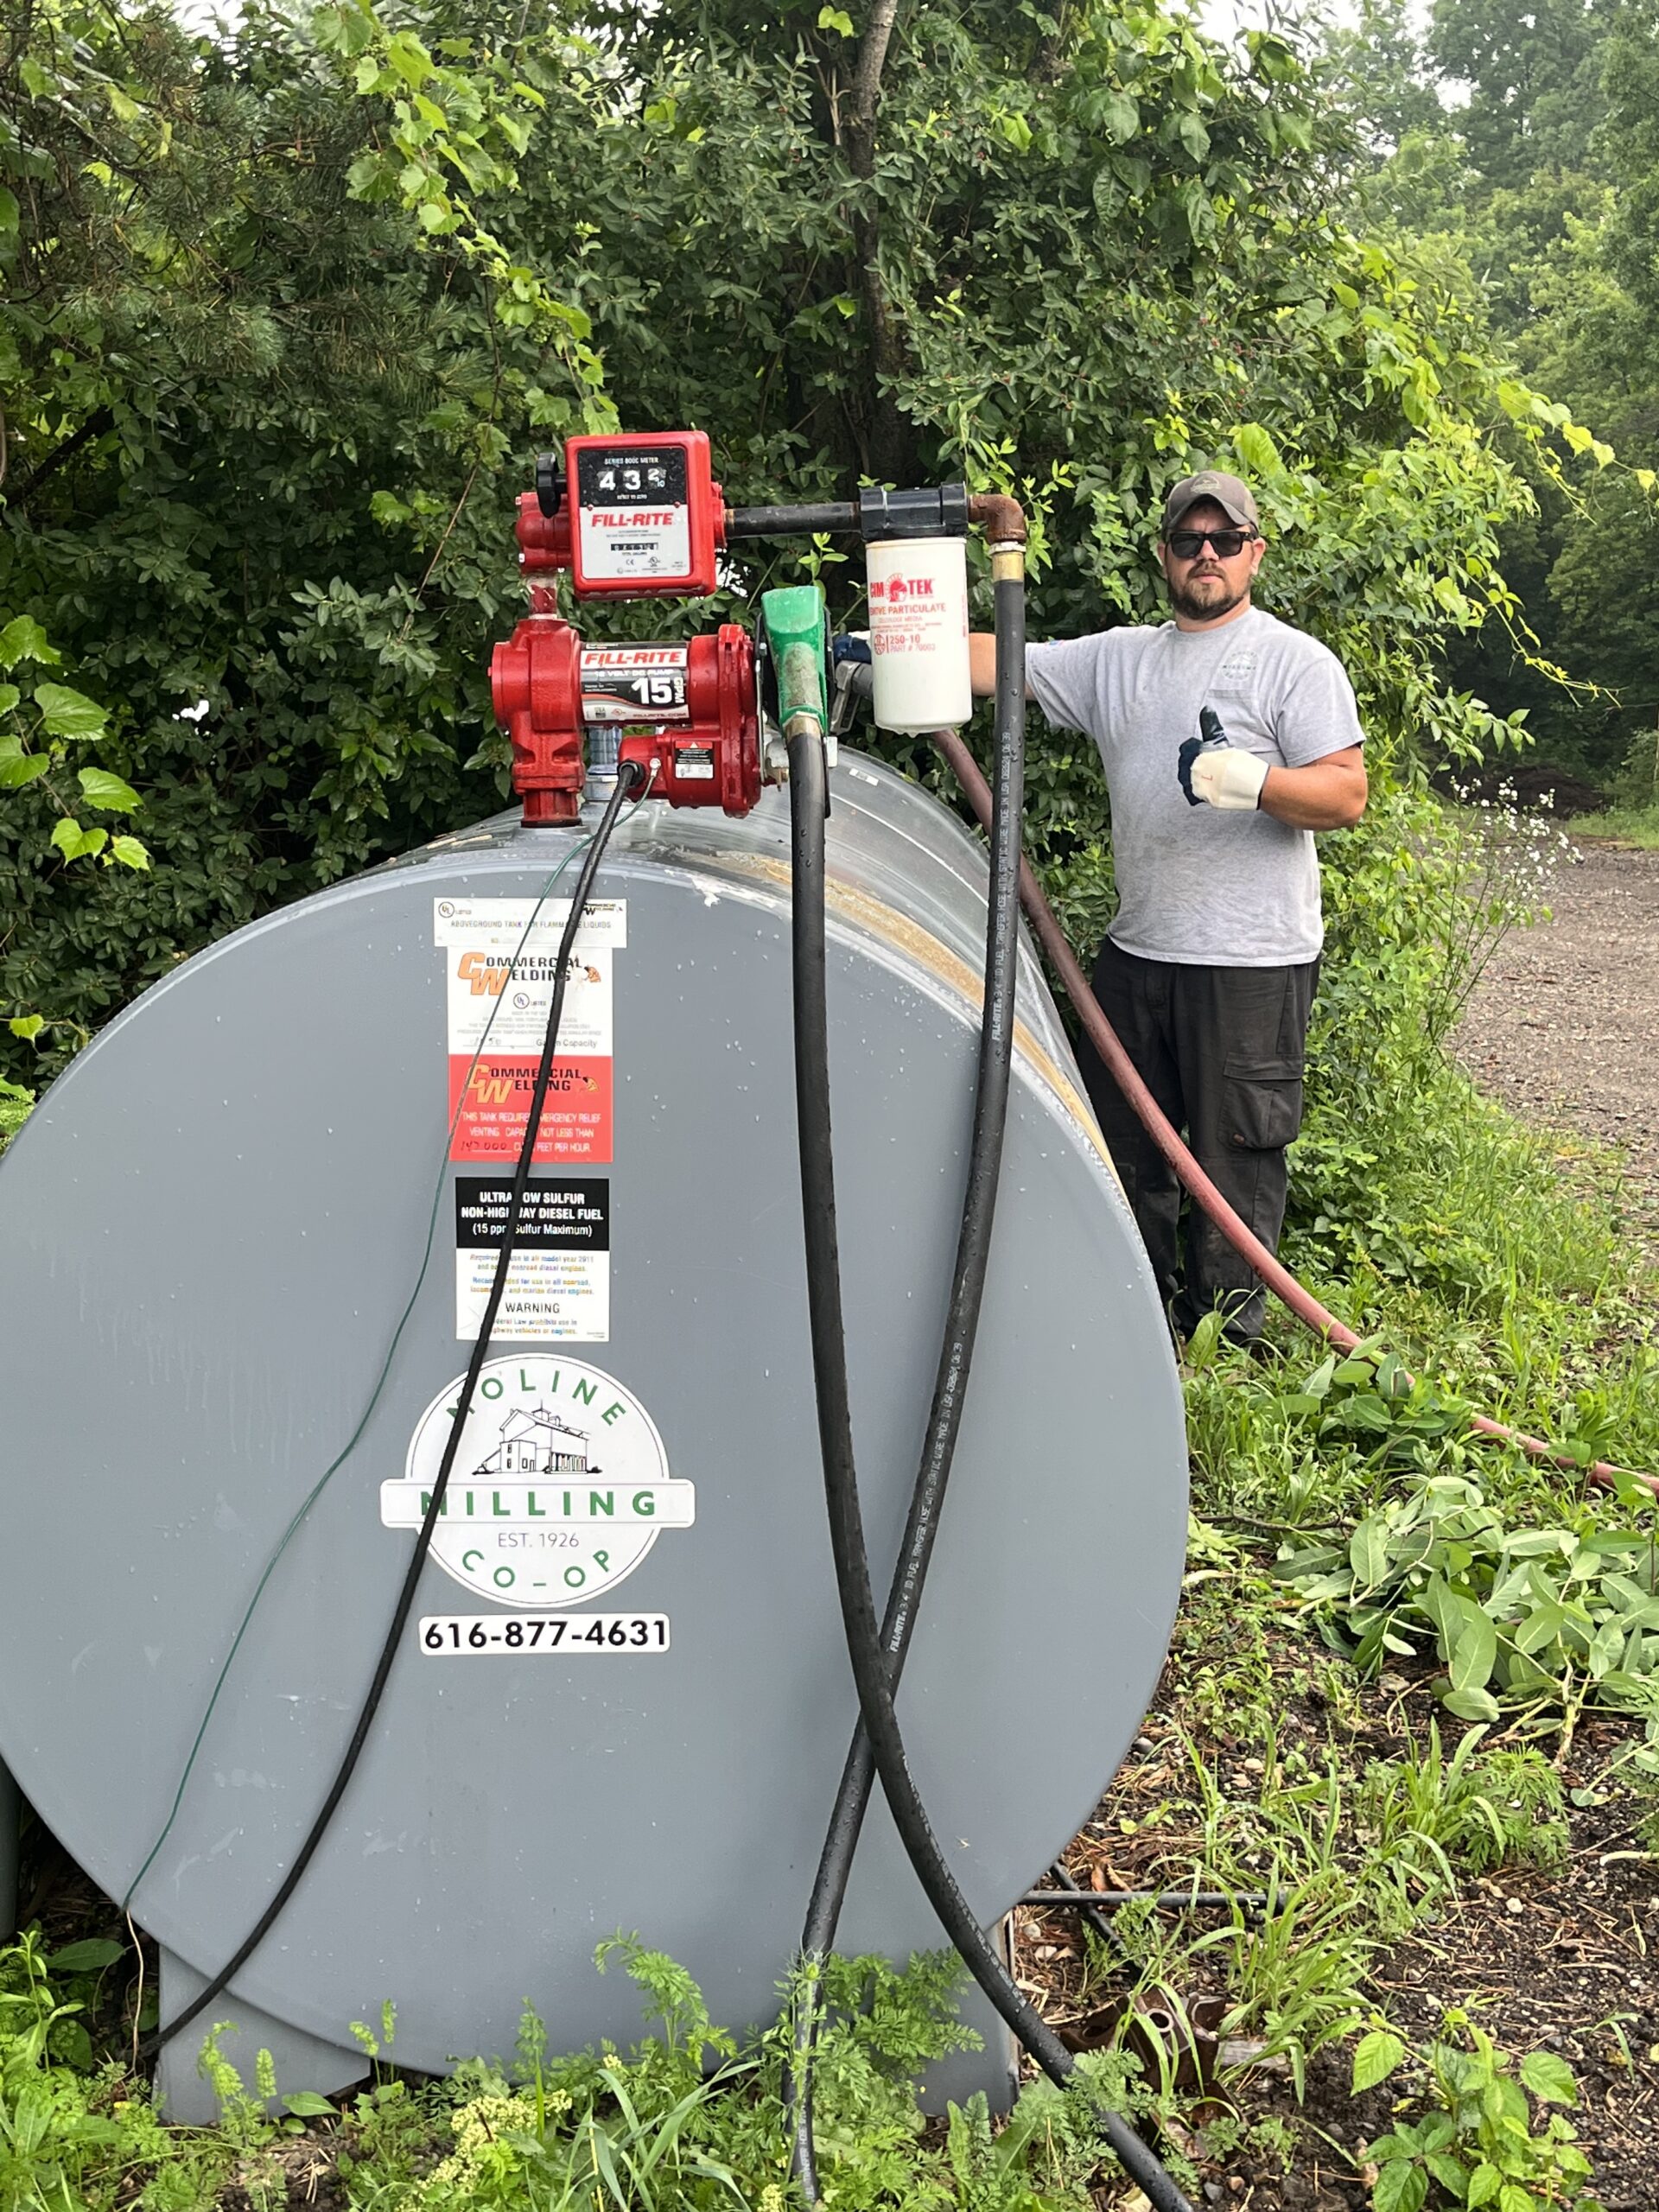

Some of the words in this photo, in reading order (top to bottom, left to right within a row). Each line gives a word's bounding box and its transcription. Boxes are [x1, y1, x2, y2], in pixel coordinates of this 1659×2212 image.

[592, 512, 673, 527] FILL-RITE
[907, 578, 933, 595] TEK
[888, 603, 946, 615] PARTICULATE
[890, 634, 920, 644] 250-10
[585, 652, 682, 664] FILL-RITE
[632, 677, 672, 704] 15
[674, 677, 685, 703] GPM
[458, 952, 582, 979] COMMERCAL
[563, 1039, 597, 1048] Capacity
[467, 1065, 582, 1089] COMMECIAL
[477, 1079, 570, 1104] WELNG
[462, 1112, 478, 1122] THIS
[480, 1112, 497, 1122] TANK
[499, 1112, 530, 1122] REQUIRE
[540, 1113, 576, 1122] MERGENCY
[578, 1113, 601, 1123] RELIEF
[469, 1127, 499, 1137] VENTING
[505, 1127, 528, 1137] CAPAC
[540, 1127, 555, 1137] NOT
[556, 1128, 574, 1137] LESS
[575, 1128, 594, 1137] THAN
[537, 1142, 552, 1152] FEET
[555, 1142, 568, 1152] PER
[570, 1142, 591, 1153] HOUR.
[480, 1191, 512, 1203] ULTRA
[523, 1192, 541, 1204] OW
[543, 1192, 585, 1205] SULFUR
[461, 1206, 536, 1219] NON-HIGAY
[538, 1208, 575, 1219] DIESEL
[577, 1209, 604, 1220] FUEL
[473, 1223, 488, 1235] (15
[515, 1223, 541, 1235] Sulfur
[543, 1224, 592, 1237] Maximum)
[505, 1302, 560, 1313] WARNING
[421, 1491, 656, 1516] MILLING
[499, 1533, 532, 1548] EST.
[539, 1533, 579, 1548] 1926
[425, 1619, 665, 1649] 616-877-4631
